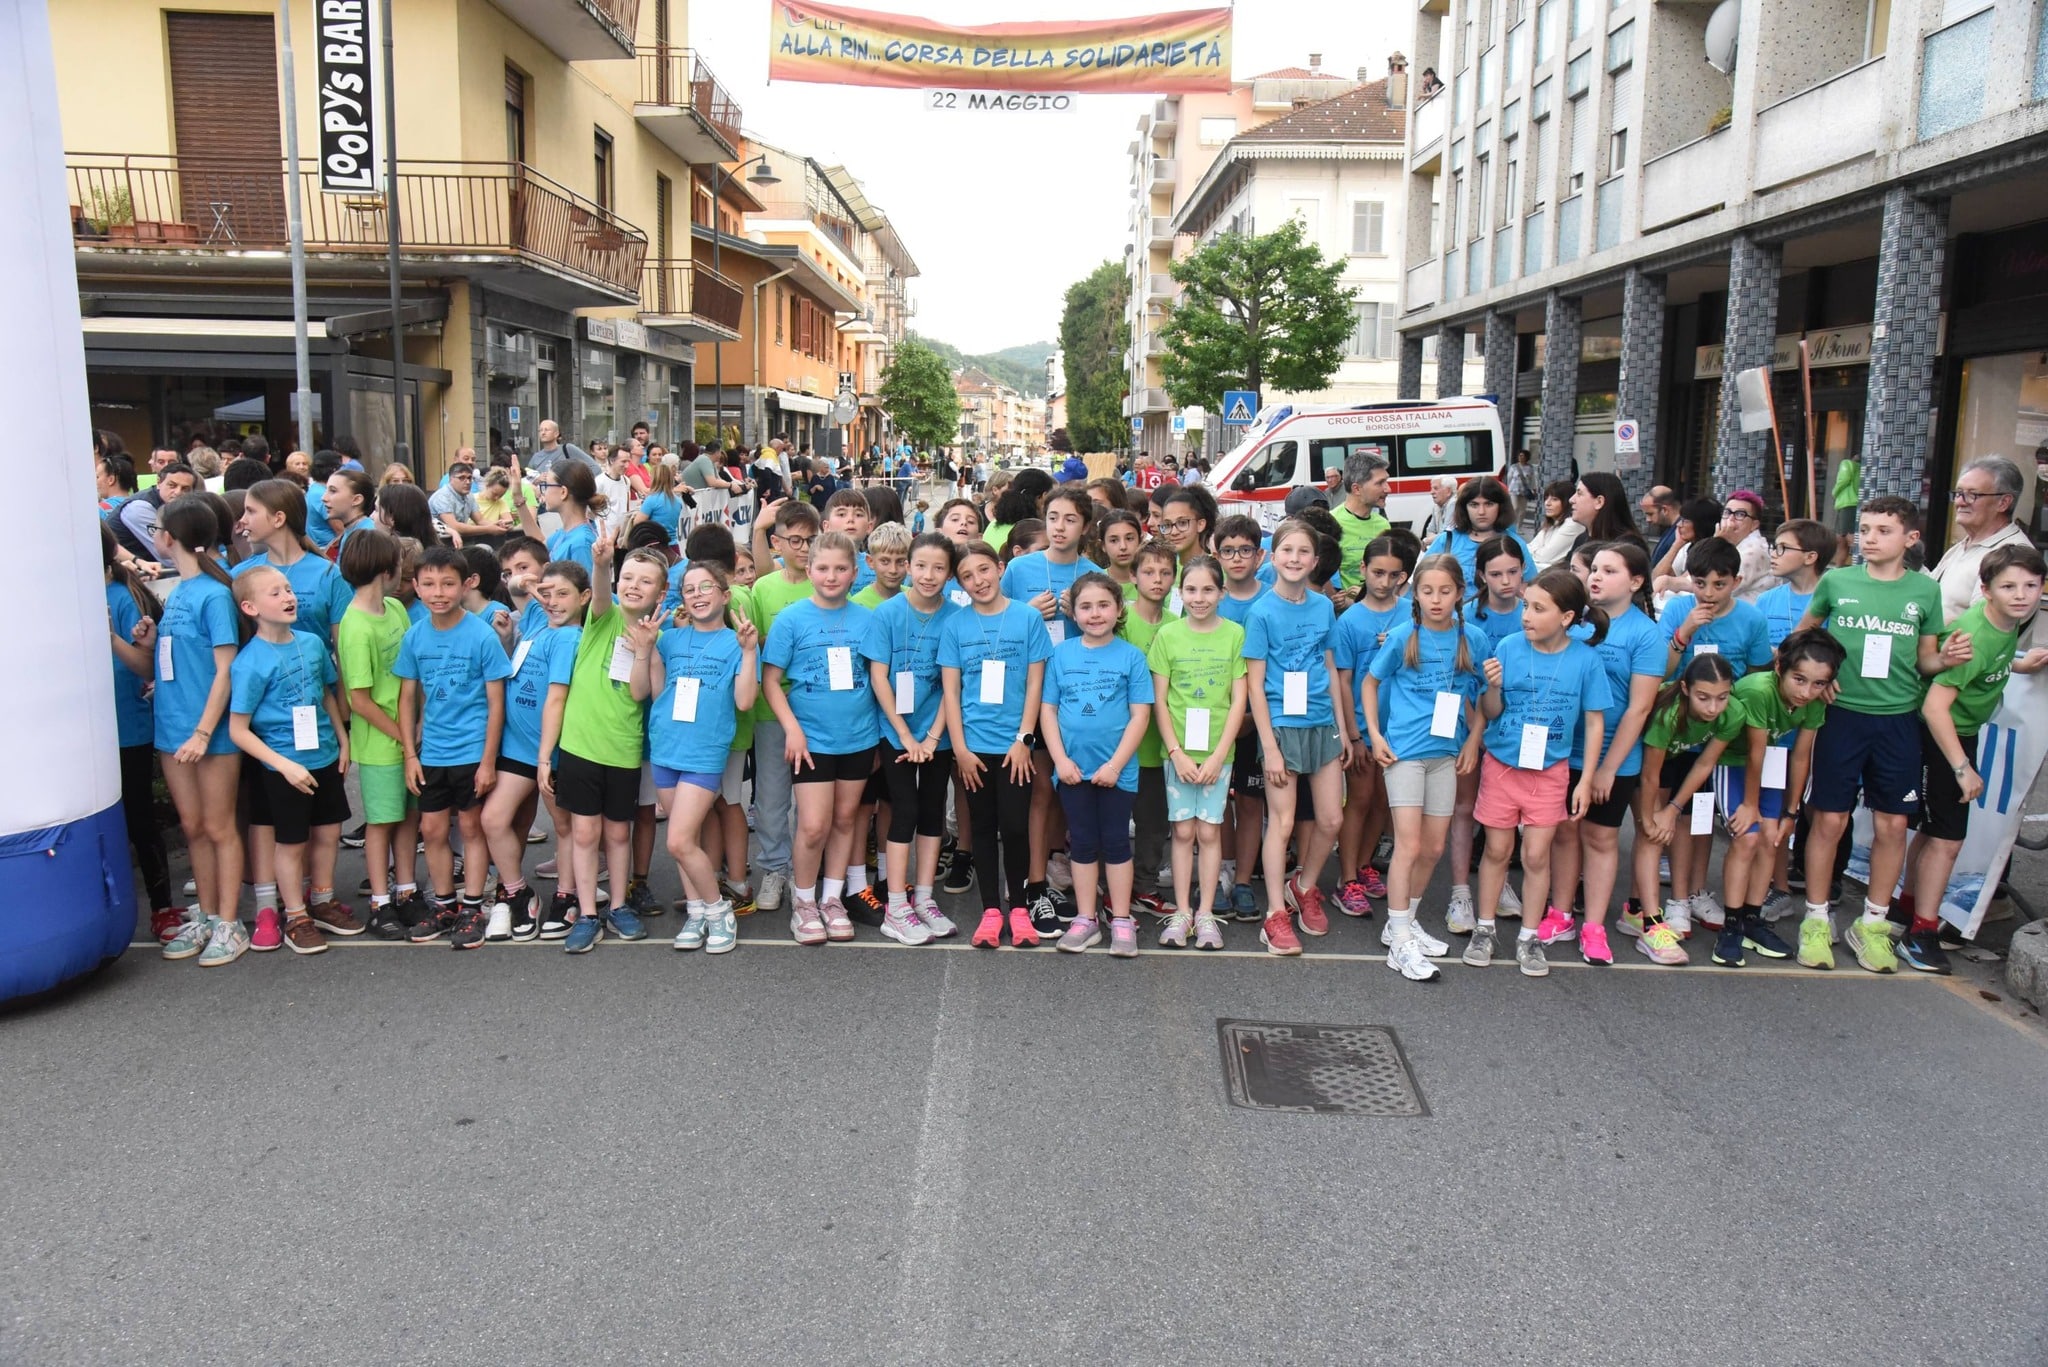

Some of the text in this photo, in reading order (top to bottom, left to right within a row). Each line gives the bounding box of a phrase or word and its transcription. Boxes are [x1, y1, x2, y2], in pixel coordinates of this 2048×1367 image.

[322, 0, 364, 64] BAR
[814, 18, 845, 31] LILT
[779, 32, 832, 57] ALLA
[972, 46, 1054, 68] DELLA
[932, 91, 1071, 111] 22 MAGGIO
[1327, 411, 1453, 426] CROCE ROSSA ITALIANA
[1365, 422, 1421, 431] BORGOSESIA
